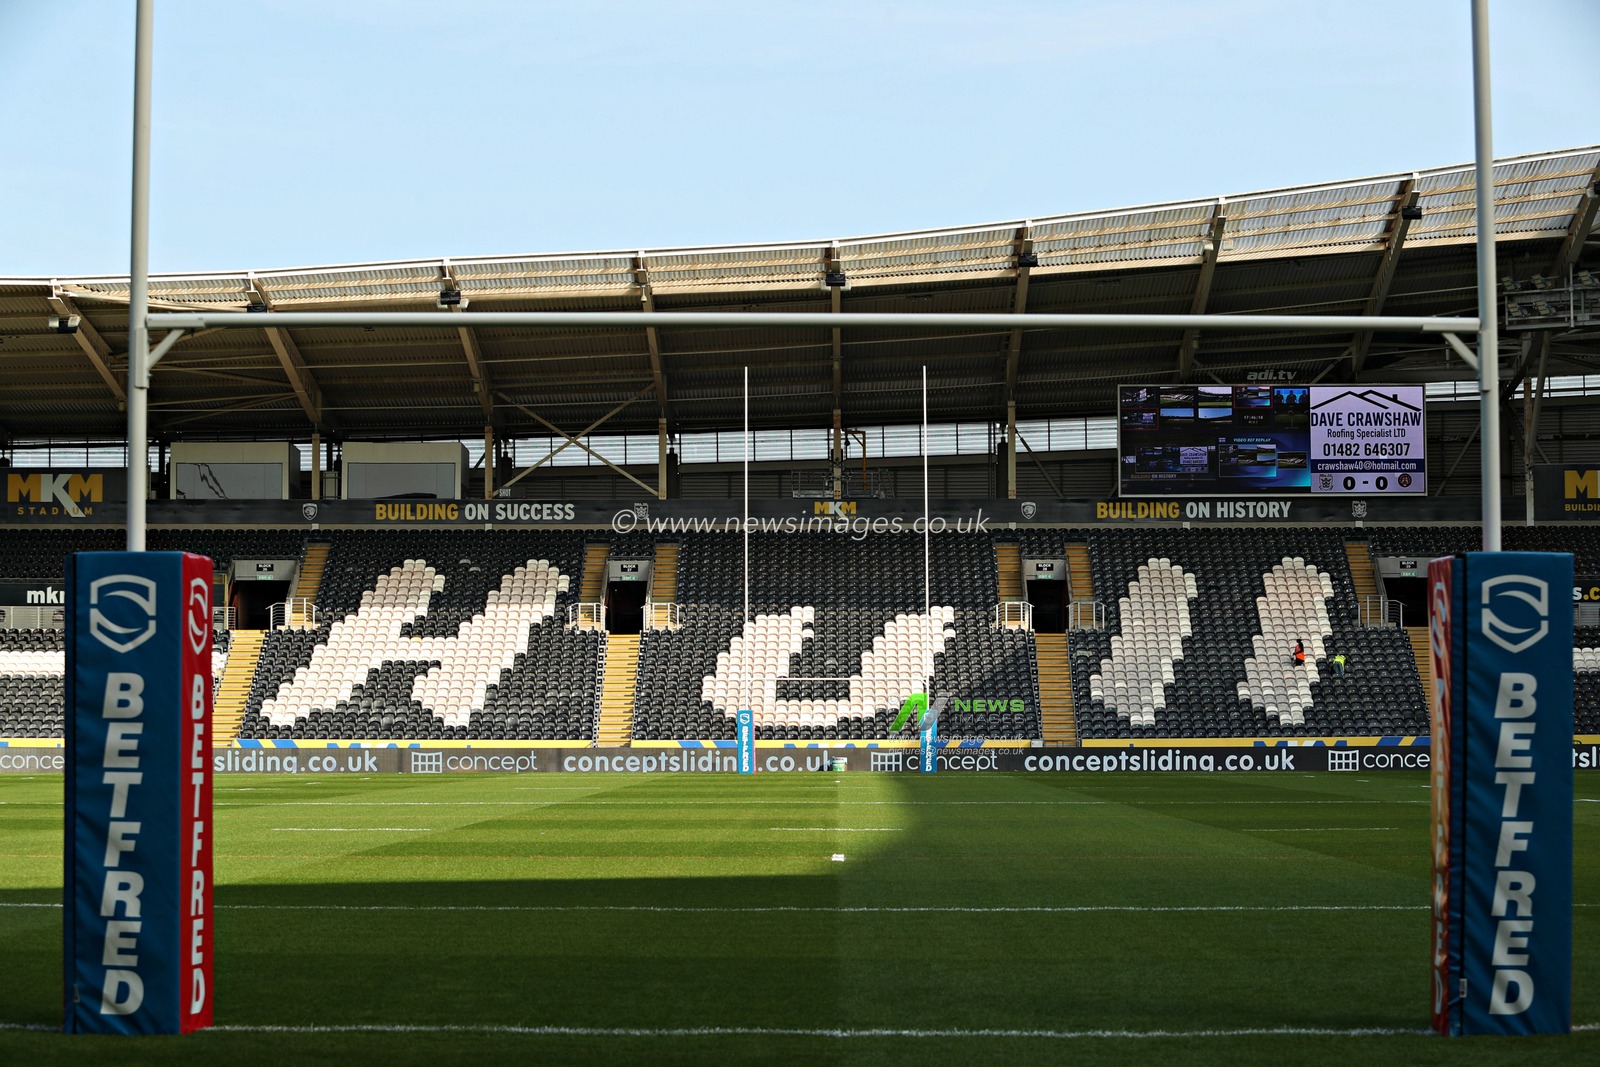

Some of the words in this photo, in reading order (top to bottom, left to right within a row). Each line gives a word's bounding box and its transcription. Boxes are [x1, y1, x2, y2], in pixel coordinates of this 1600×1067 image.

[1247, 370, 1297, 380] adi.tv
[1311, 412, 1343, 427] DAVE
[1347, 412, 1421, 427] CRAWSHAW
[1327, 428, 1355, 440] Roofing
[1356, 428, 1392, 440] Specialist
[1393, 429, 1406, 438] LTD
[1323, 443, 1360, 456] 01482
[1364, 443, 1411, 456] 646307
[1317, 461, 1417, 471] crawshaw40@hotmail.com
[1564, 470, 1600, 499] M
[8, 473, 103, 517] MKM
[17, 506, 93, 515] STADIUM
[375, 503, 458, 521] BUILDING
[464, 503, 489, 521] ON
[495, 503, 575, 521] SUCCESS
[814, 501, 857, 517] MKM
[1096, 501, 1180, 518] BUILDING
[1185, 501, 1210, 518] ON
[1216, 501, 1292, 518] HISTORY
[742, 725, 750, 772] BETFRED
[0, 754, 65, 770] conce
[213, 750, 378, 773] sliding.co.uk
[446, 750, 538, 773] concept
[563, 750, 832, 773] conceptslidin.co.uk
[906, 750, 999, 771] cncept
[1024, 749, 1295, 771] conceptsliding.co.uk
[1363, 753, 1431, 768] conce
[100, 672, 145, 1016] BETFRED
[190, 673, 205, 1015] BETFRED
[1488, 672, 1538, 1016] BETFRED
